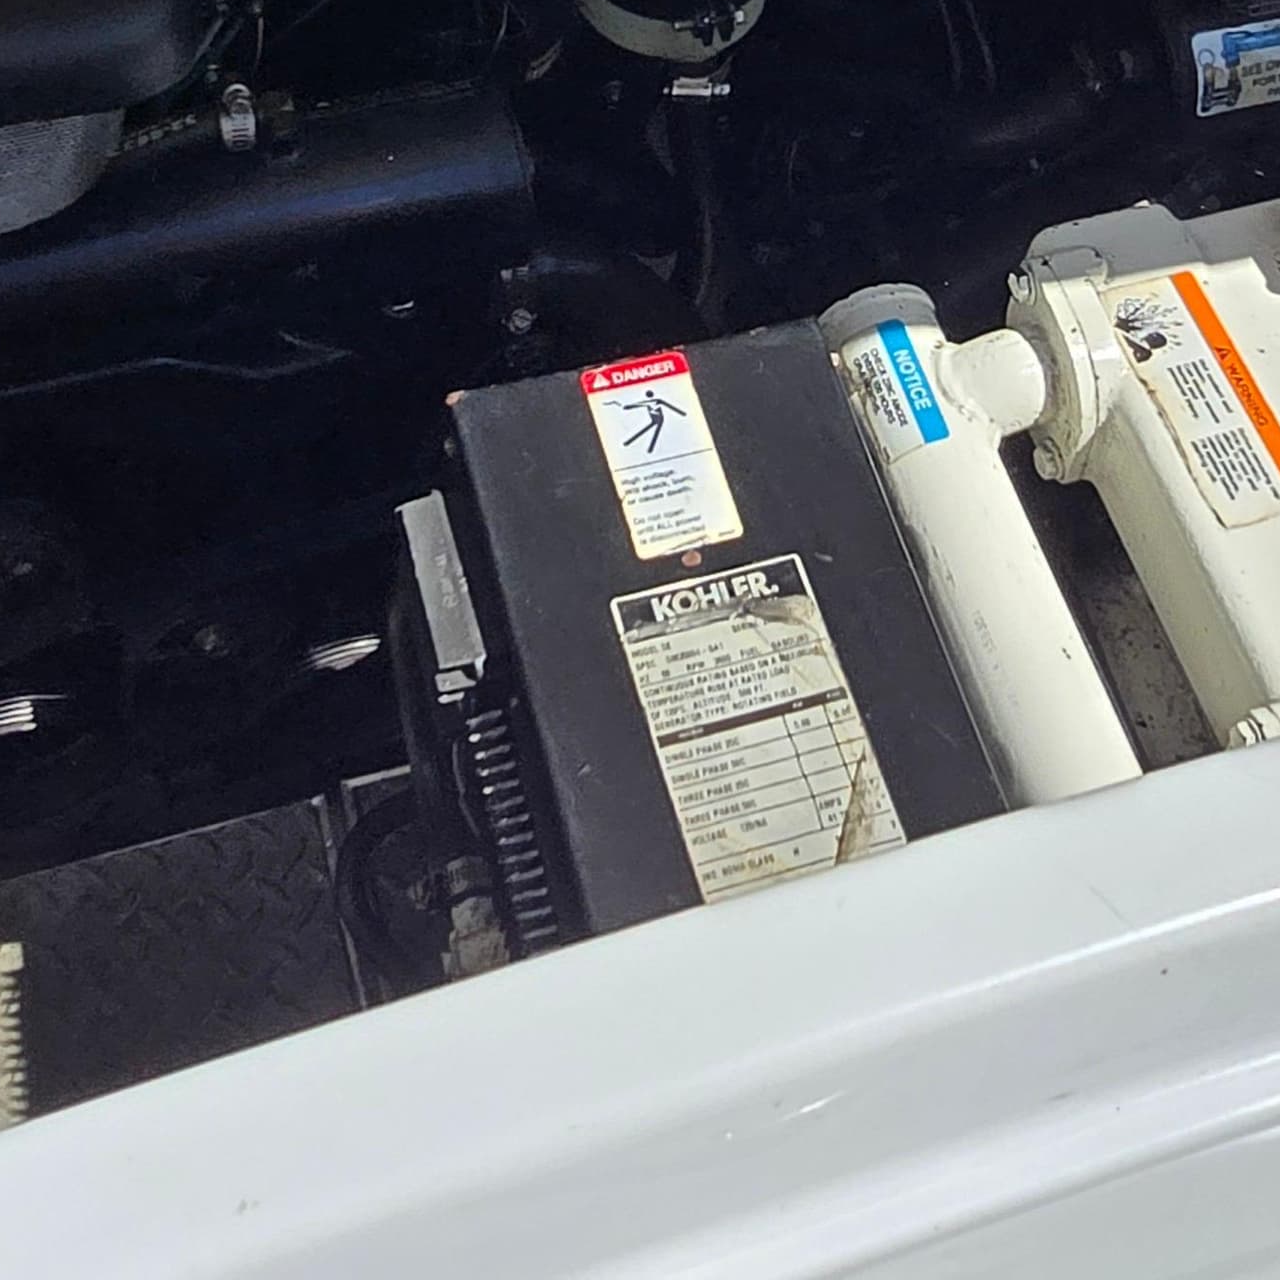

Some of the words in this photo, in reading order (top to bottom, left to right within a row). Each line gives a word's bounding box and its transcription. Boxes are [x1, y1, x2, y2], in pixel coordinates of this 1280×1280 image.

[611, 360, 676, 385] DANGER
[893, 348, 932, 410] NOTICE
[1228, 363, 1269, 427] WARNING
[695, 742, 722, 755] PHASE
[702, 762, 728, 776] PHASE
[706, 783, 732, 797] PHASE
[713, 803, 740, 816] PHASE
